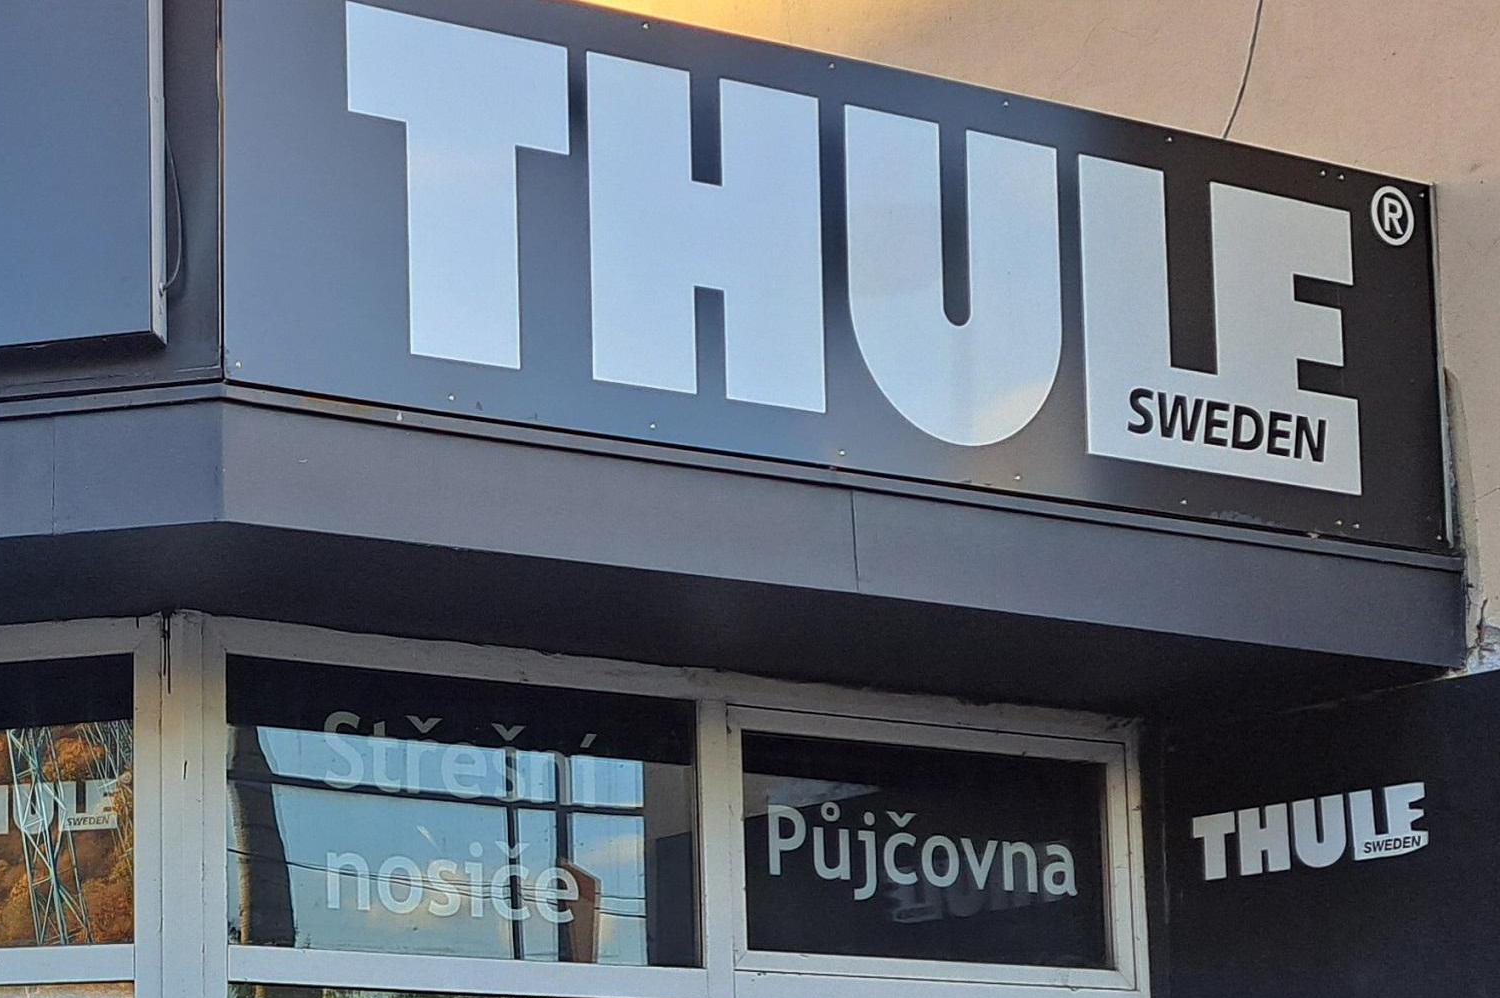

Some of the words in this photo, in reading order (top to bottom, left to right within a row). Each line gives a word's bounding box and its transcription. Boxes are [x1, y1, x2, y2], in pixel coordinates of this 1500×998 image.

[346, 1, 1363, 496] THULE
[1127, 387, 1327, 464] SWEDEN
[323, 711, 597, 805] Střešní
[66, 815, 110, 826] SWEDEN
[768, 802, 1078, 902] Půjčovna
[1192, 782, 1429, 881] THULE
[1363, 835, 1422, 855] SWEDEN
[325, 841, 580, 923] nosiče
